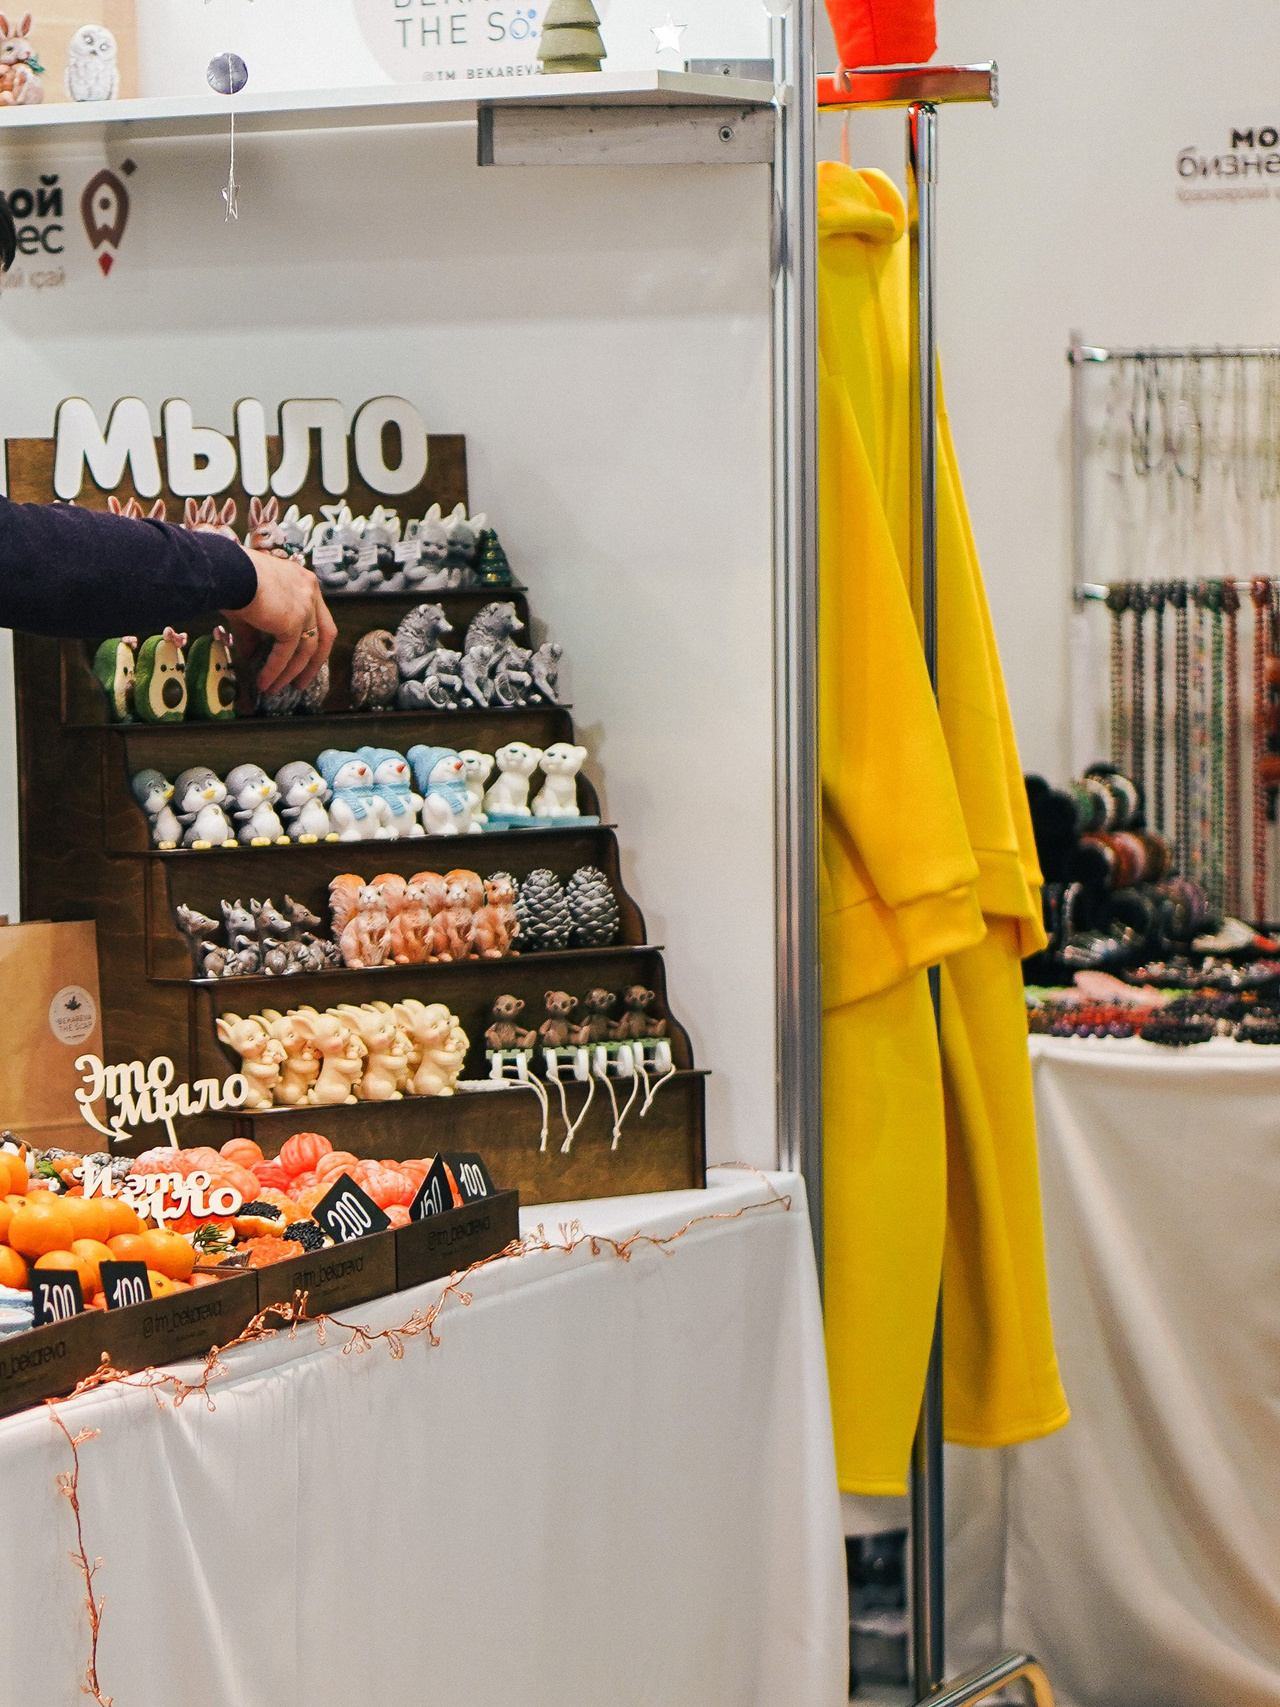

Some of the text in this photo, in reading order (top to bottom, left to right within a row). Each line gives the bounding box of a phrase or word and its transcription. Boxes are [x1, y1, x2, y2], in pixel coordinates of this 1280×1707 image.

[394, 14, 467, 48] THE
[1231, 126, 1280, 147] мо
[8, 174, 63, 219] ой
[54, 395, 428, 499] МЫЛО
[74, 1054, 175, 1103] Это
[72, 1155, 212, 1199] И это
[459, 1162, 488, 1197] 100
[119, 1187, 243, 1220] ыло
[326, 1191, 372, 1243] 200
[39, 1283, 77, 1325] 300
[112, 1276, 145, 1309] 100
